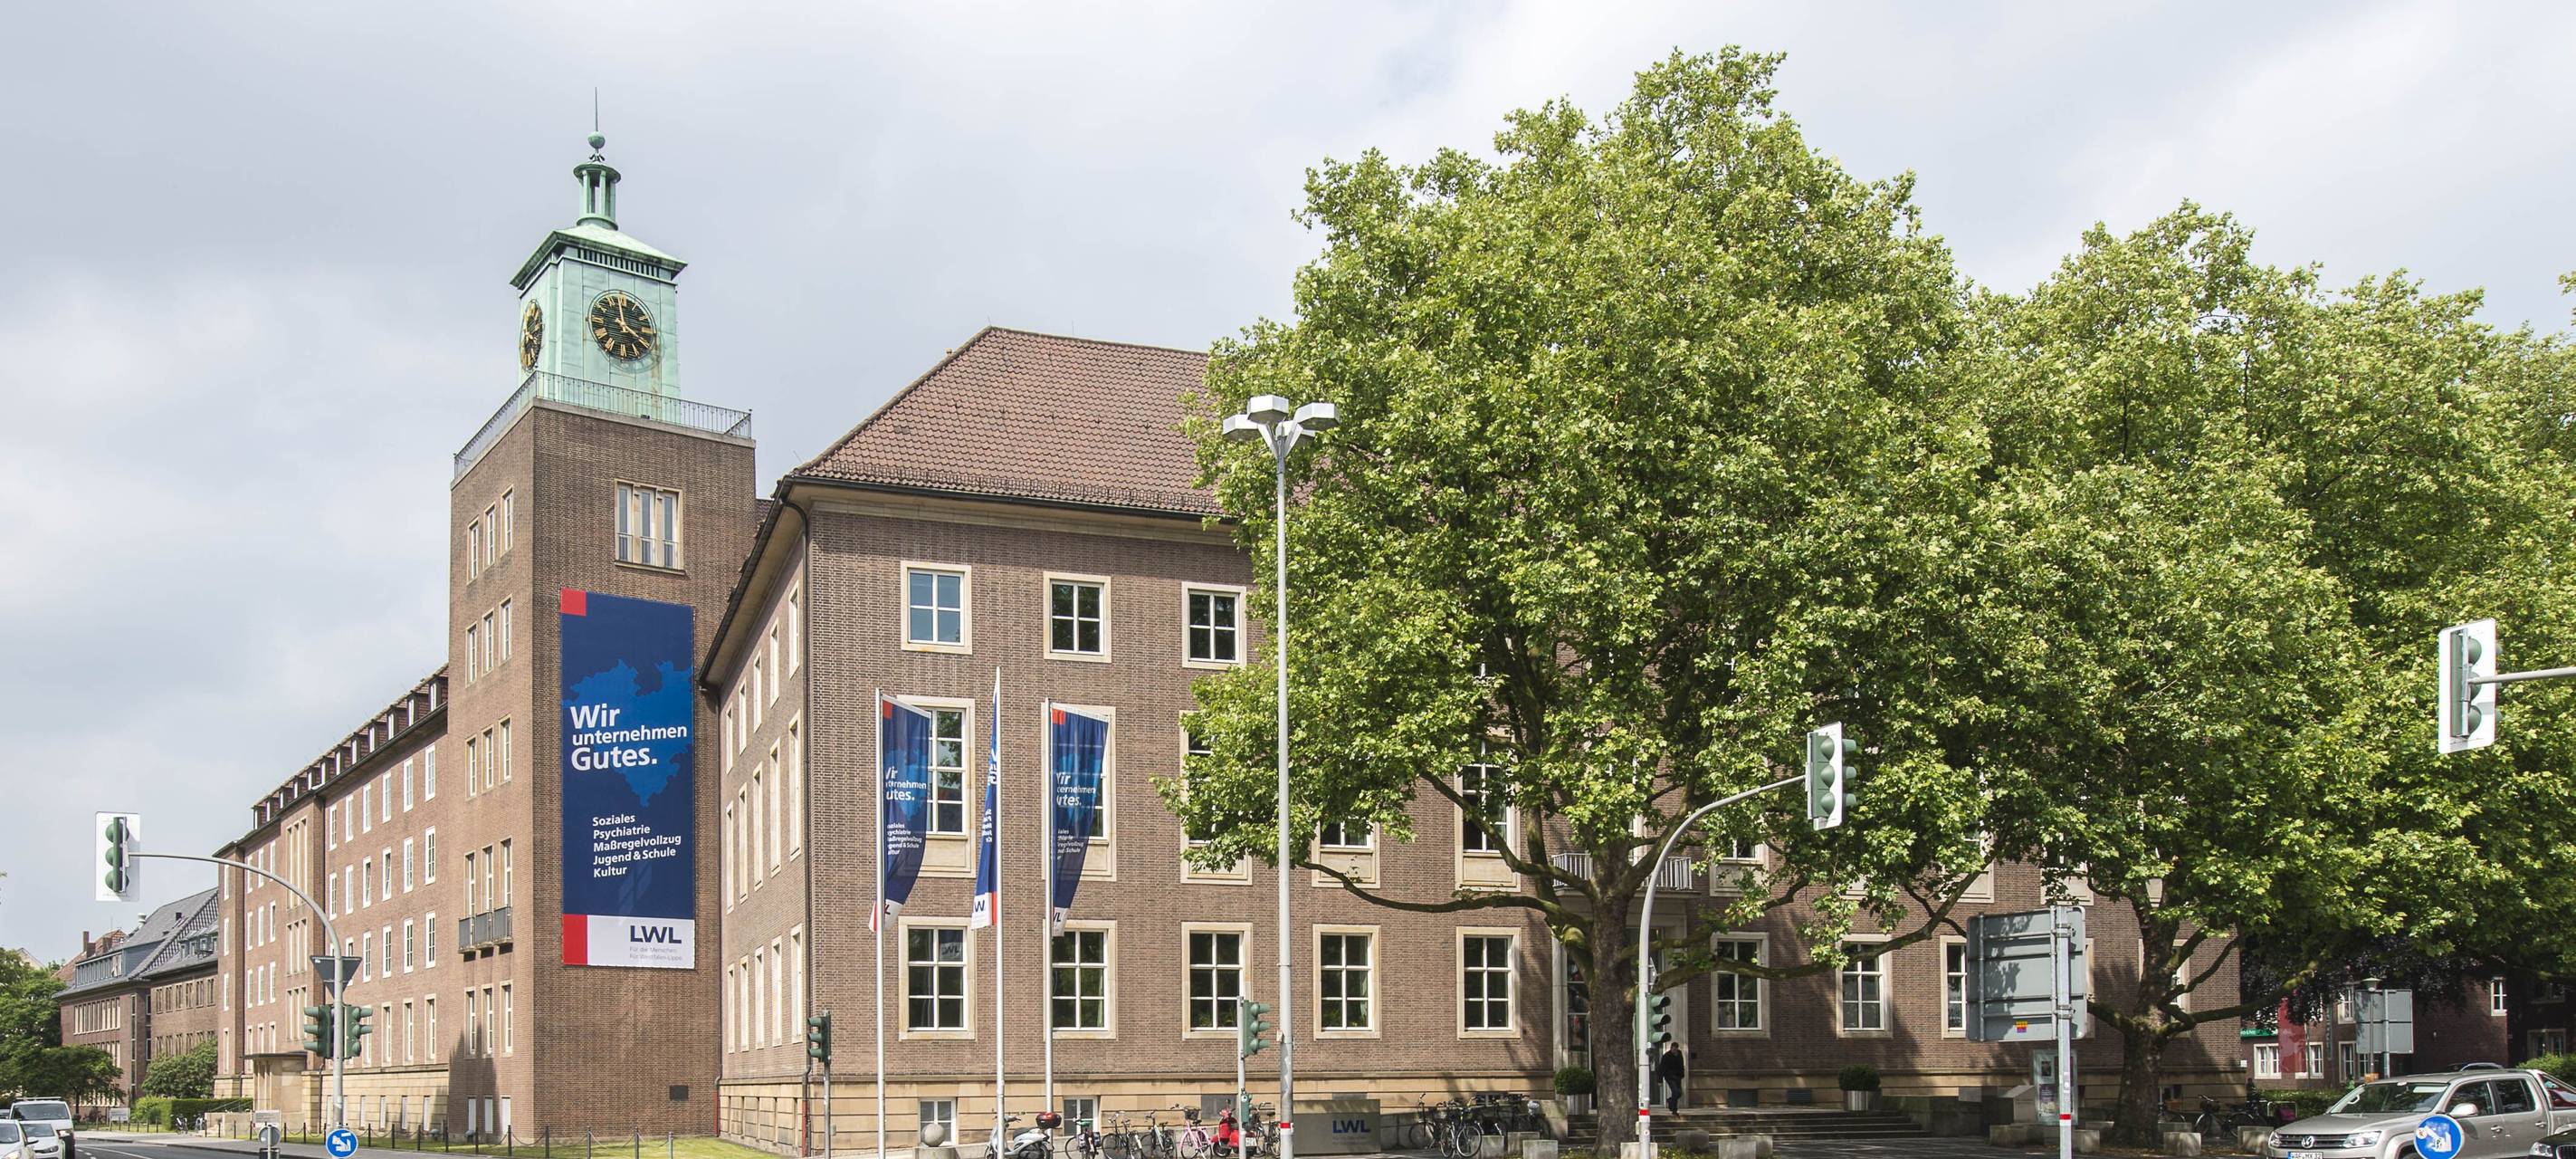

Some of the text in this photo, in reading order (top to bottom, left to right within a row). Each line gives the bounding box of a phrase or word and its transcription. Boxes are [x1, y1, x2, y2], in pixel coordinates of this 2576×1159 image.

[570, 703, 621, 729] Wir
[572, 724, 688, 746] unternehmen
[571, 746, 658, 771] Gutes.
[886, 789, 915, 800] utes.
[1056, 794, 1083, 806] utes.
[592, 813, 635, 827] Soziales
[593, 824, 651, 840] Psychiatrie
[593, 835, 682, 852] Maßregelvollzug
[593, 846, 677, 866] Jugend & Schule
[593, 866, 627, 877] Kultur
[630, 924, 682, 944] LWL
[1332, 1119, 1371, 1134] LWL
